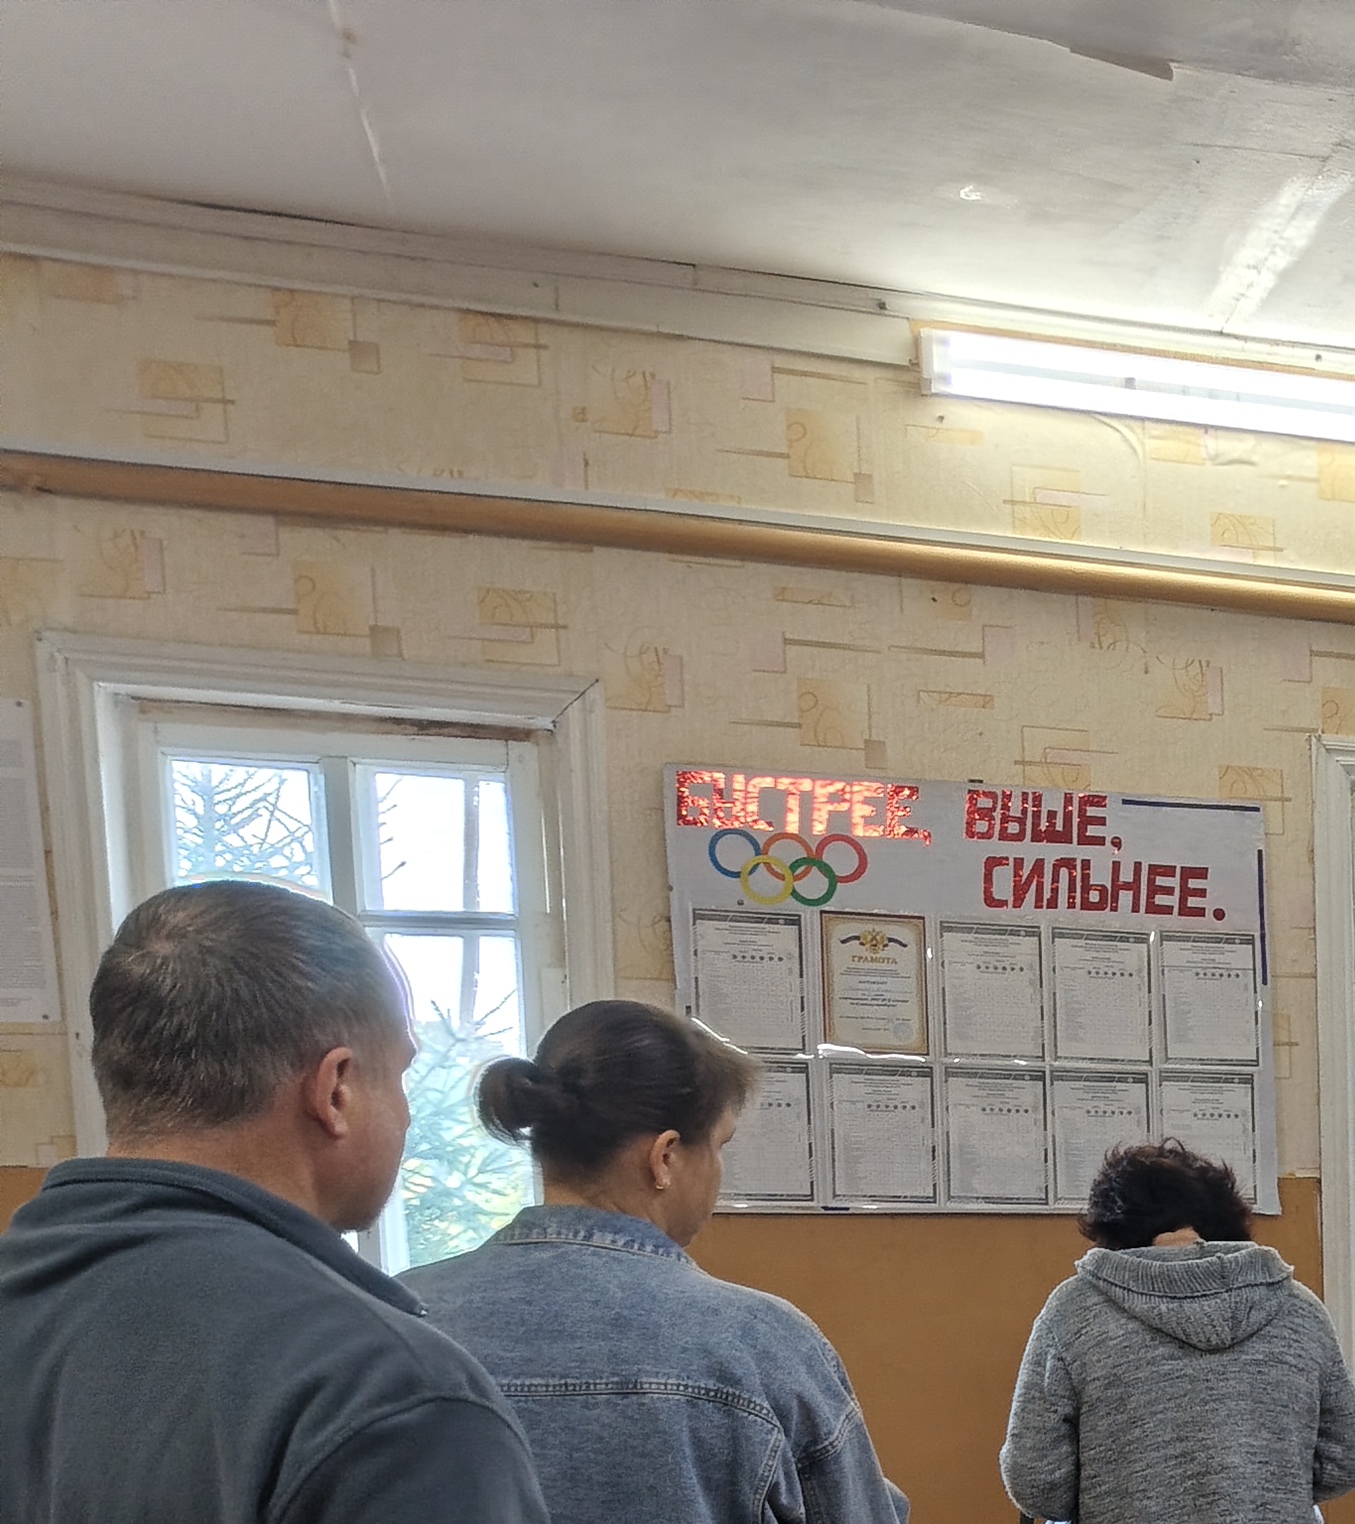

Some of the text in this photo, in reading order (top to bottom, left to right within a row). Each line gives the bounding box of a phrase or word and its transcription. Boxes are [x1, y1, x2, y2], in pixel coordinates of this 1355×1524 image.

[676, 770, 1123, 855] БЫСТРЕЕ, ВЫШЕ,
[983, 856, 1226, 921] СИЛЬНЕЕ.
